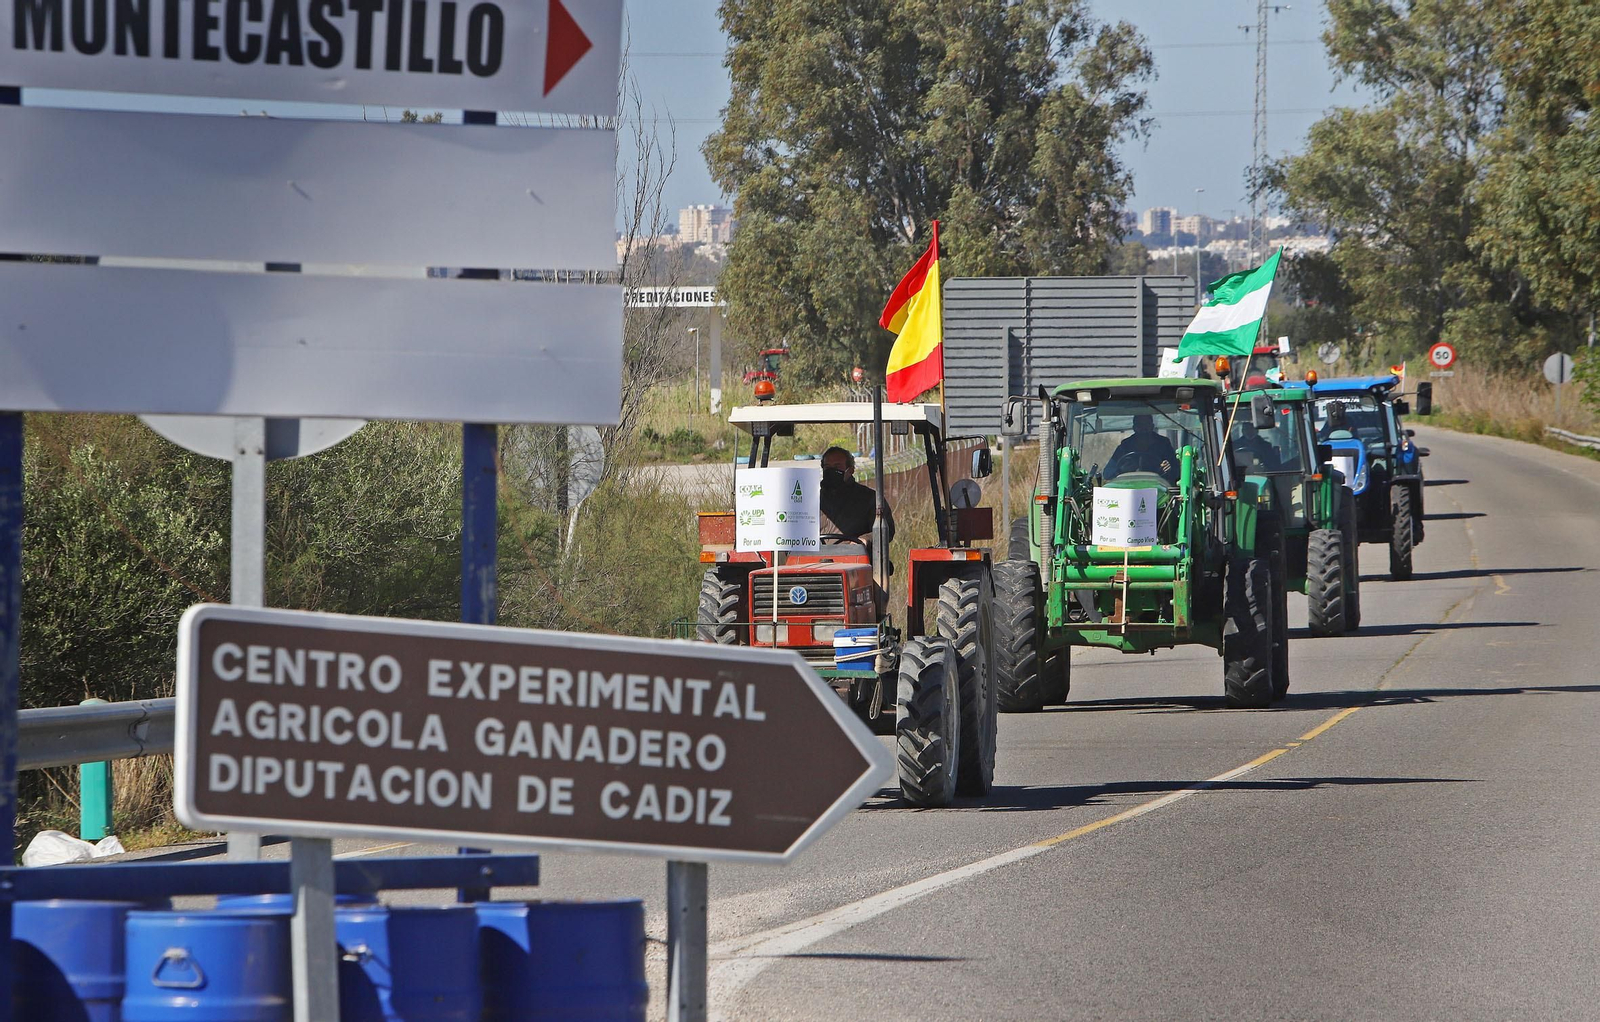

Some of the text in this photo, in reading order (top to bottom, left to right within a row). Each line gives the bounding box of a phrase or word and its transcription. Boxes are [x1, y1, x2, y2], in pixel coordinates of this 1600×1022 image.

[12, 0, 506, 78] MONTECASTILLO
[1435, 351, 1449, 360] 50
[743, 538, 752, 546] Por
[775, 536, 800, 547] Campo
[801, 537, 816, 546] Vivo
[1126, 537, 1144, 545] Campo
[212, 642, 767, 722] CENTRO EXPERIMENTAL
[211, 698, 727, 772] AGRICOLA GANADERO
[209, 754, 733, 827] DIPUTACION DE CADIZ
